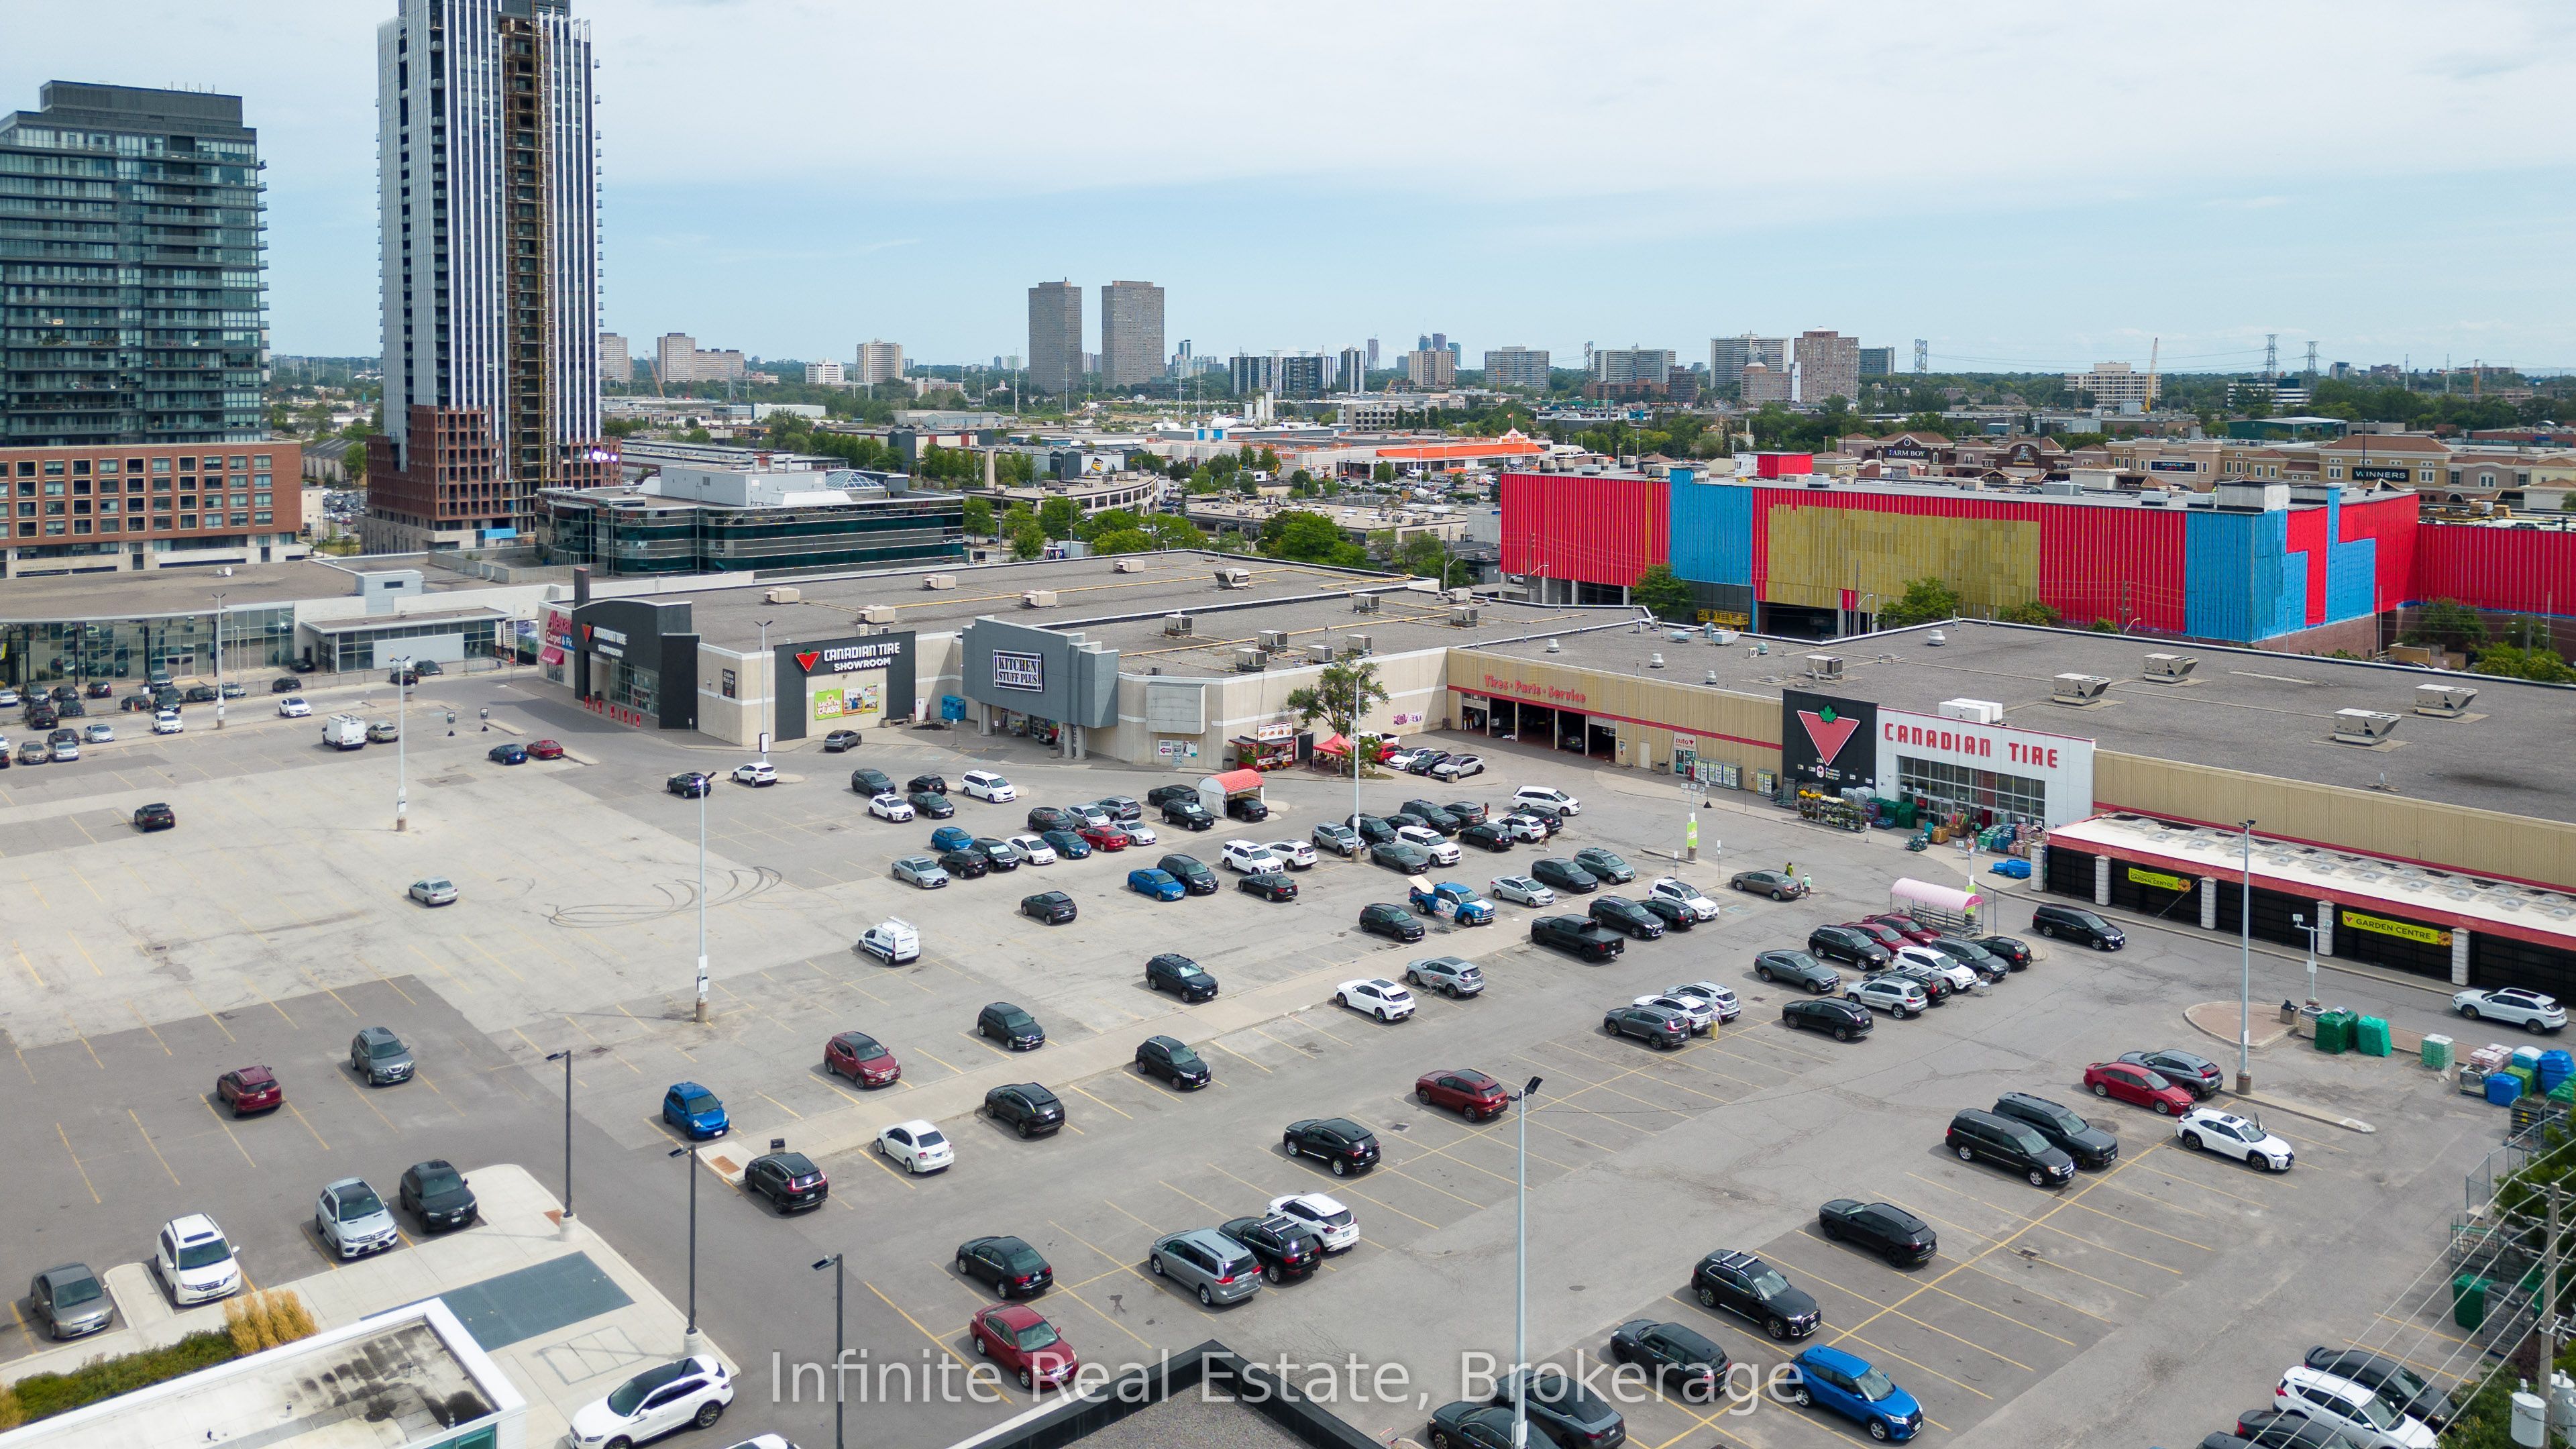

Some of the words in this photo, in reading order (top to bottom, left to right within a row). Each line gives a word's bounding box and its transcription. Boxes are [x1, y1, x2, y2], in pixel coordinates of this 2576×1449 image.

[2355, 471, 2406, 479] WINNERS
[547, 632, 561, 645] Carpet
[824, 645, 876, 661] CANADIAN
[877, 642, 900, 655] TIRE
[834, 657, 891, 672] SHOWROOM
[998, 657, 1037, 673] KITCHEN
[998, 672, 1019, 683] STUFF
[1020, 674, 1038, 684] PLUS
[1485, 674, 1509, 690] Tires
[1515, 680, 1541, 696] Parts
[1548, 684, 1586, 704] Service
[1885, 722, 1990, 757] CANADIAN
[2008, 742, 2057, 768] TIRE
[2356, 918, 2393, 931] GARDEN
[2396, 927, 2431, 940] CENTRE
